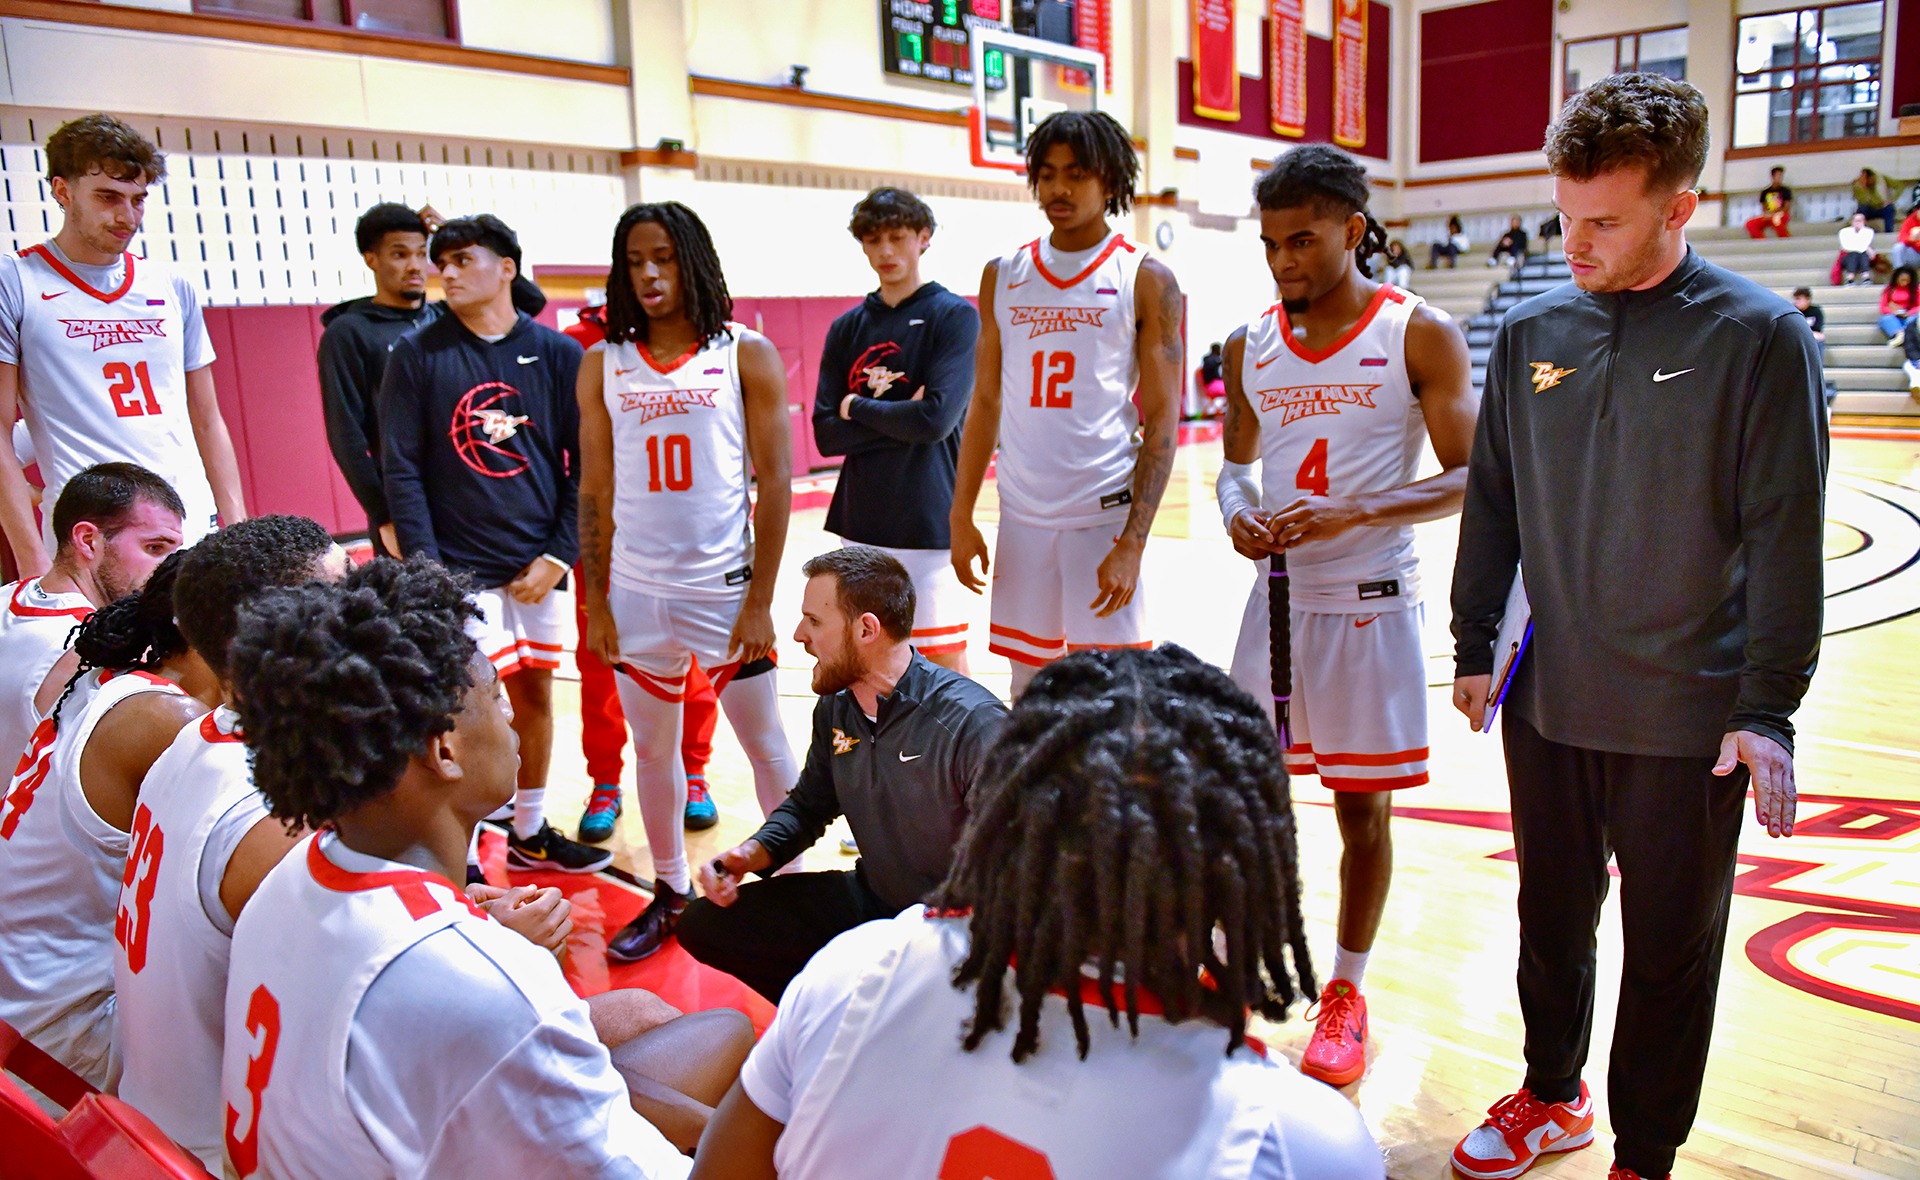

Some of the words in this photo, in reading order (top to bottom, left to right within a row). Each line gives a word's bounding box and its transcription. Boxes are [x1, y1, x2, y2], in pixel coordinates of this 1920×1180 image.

[892, 0, 934, 23] HOME
[103, 361, 162, 417] 21
[1030, 351, 1075, 408] 12
[1256, 383, 1383, 412] CHESTNUT
[646, 434, 693, 492] 10
[1296, 438, 1329, 497] 4
[115, 801, 164, 975] 23
[225, 984, 281, 1180] 3
